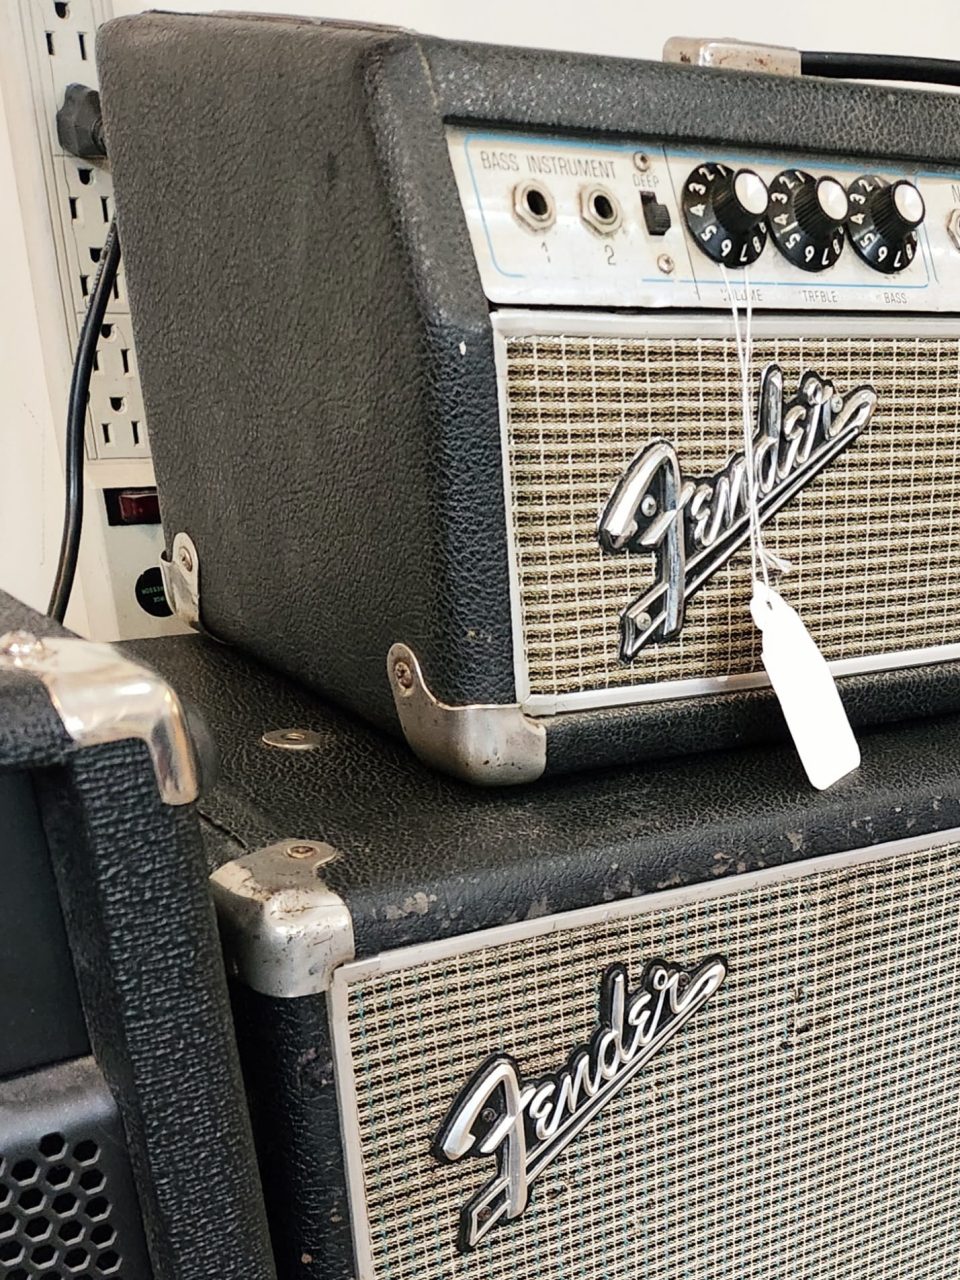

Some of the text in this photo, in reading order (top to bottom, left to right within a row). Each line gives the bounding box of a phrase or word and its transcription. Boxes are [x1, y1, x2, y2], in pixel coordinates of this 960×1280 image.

[480, 151, 617, 179] BASS INSTRUMENT
[697, 167, 716, 181] 2
[688, 182, 707, 195] 3
[779, 175, 796, 189] 2
[858, 179, 874, 192] 2
[770, 192, 788, 204] 3
[849, 193, 866, 205] 3
[689, 203, 706, 217] 4
[773, 213, 790, 226] 4
[849, 212, 866, 225] 4
[700, 224, 718, 241] 5
[784, 233, 801, 249] 5
[860, 232, 876, 248] 5
[721, 239, 732, 257] 6
[804, 245, 815, 262] 6
[877, 245, 888, 262] 6
[604, 245, 617, 266] 2
[802, 289, 838, 303] TREBLE
[884, 292, 908, 304] BASS
[598, 363, 878, 666] Fender
[433, 955, 728, 1250] Fender
